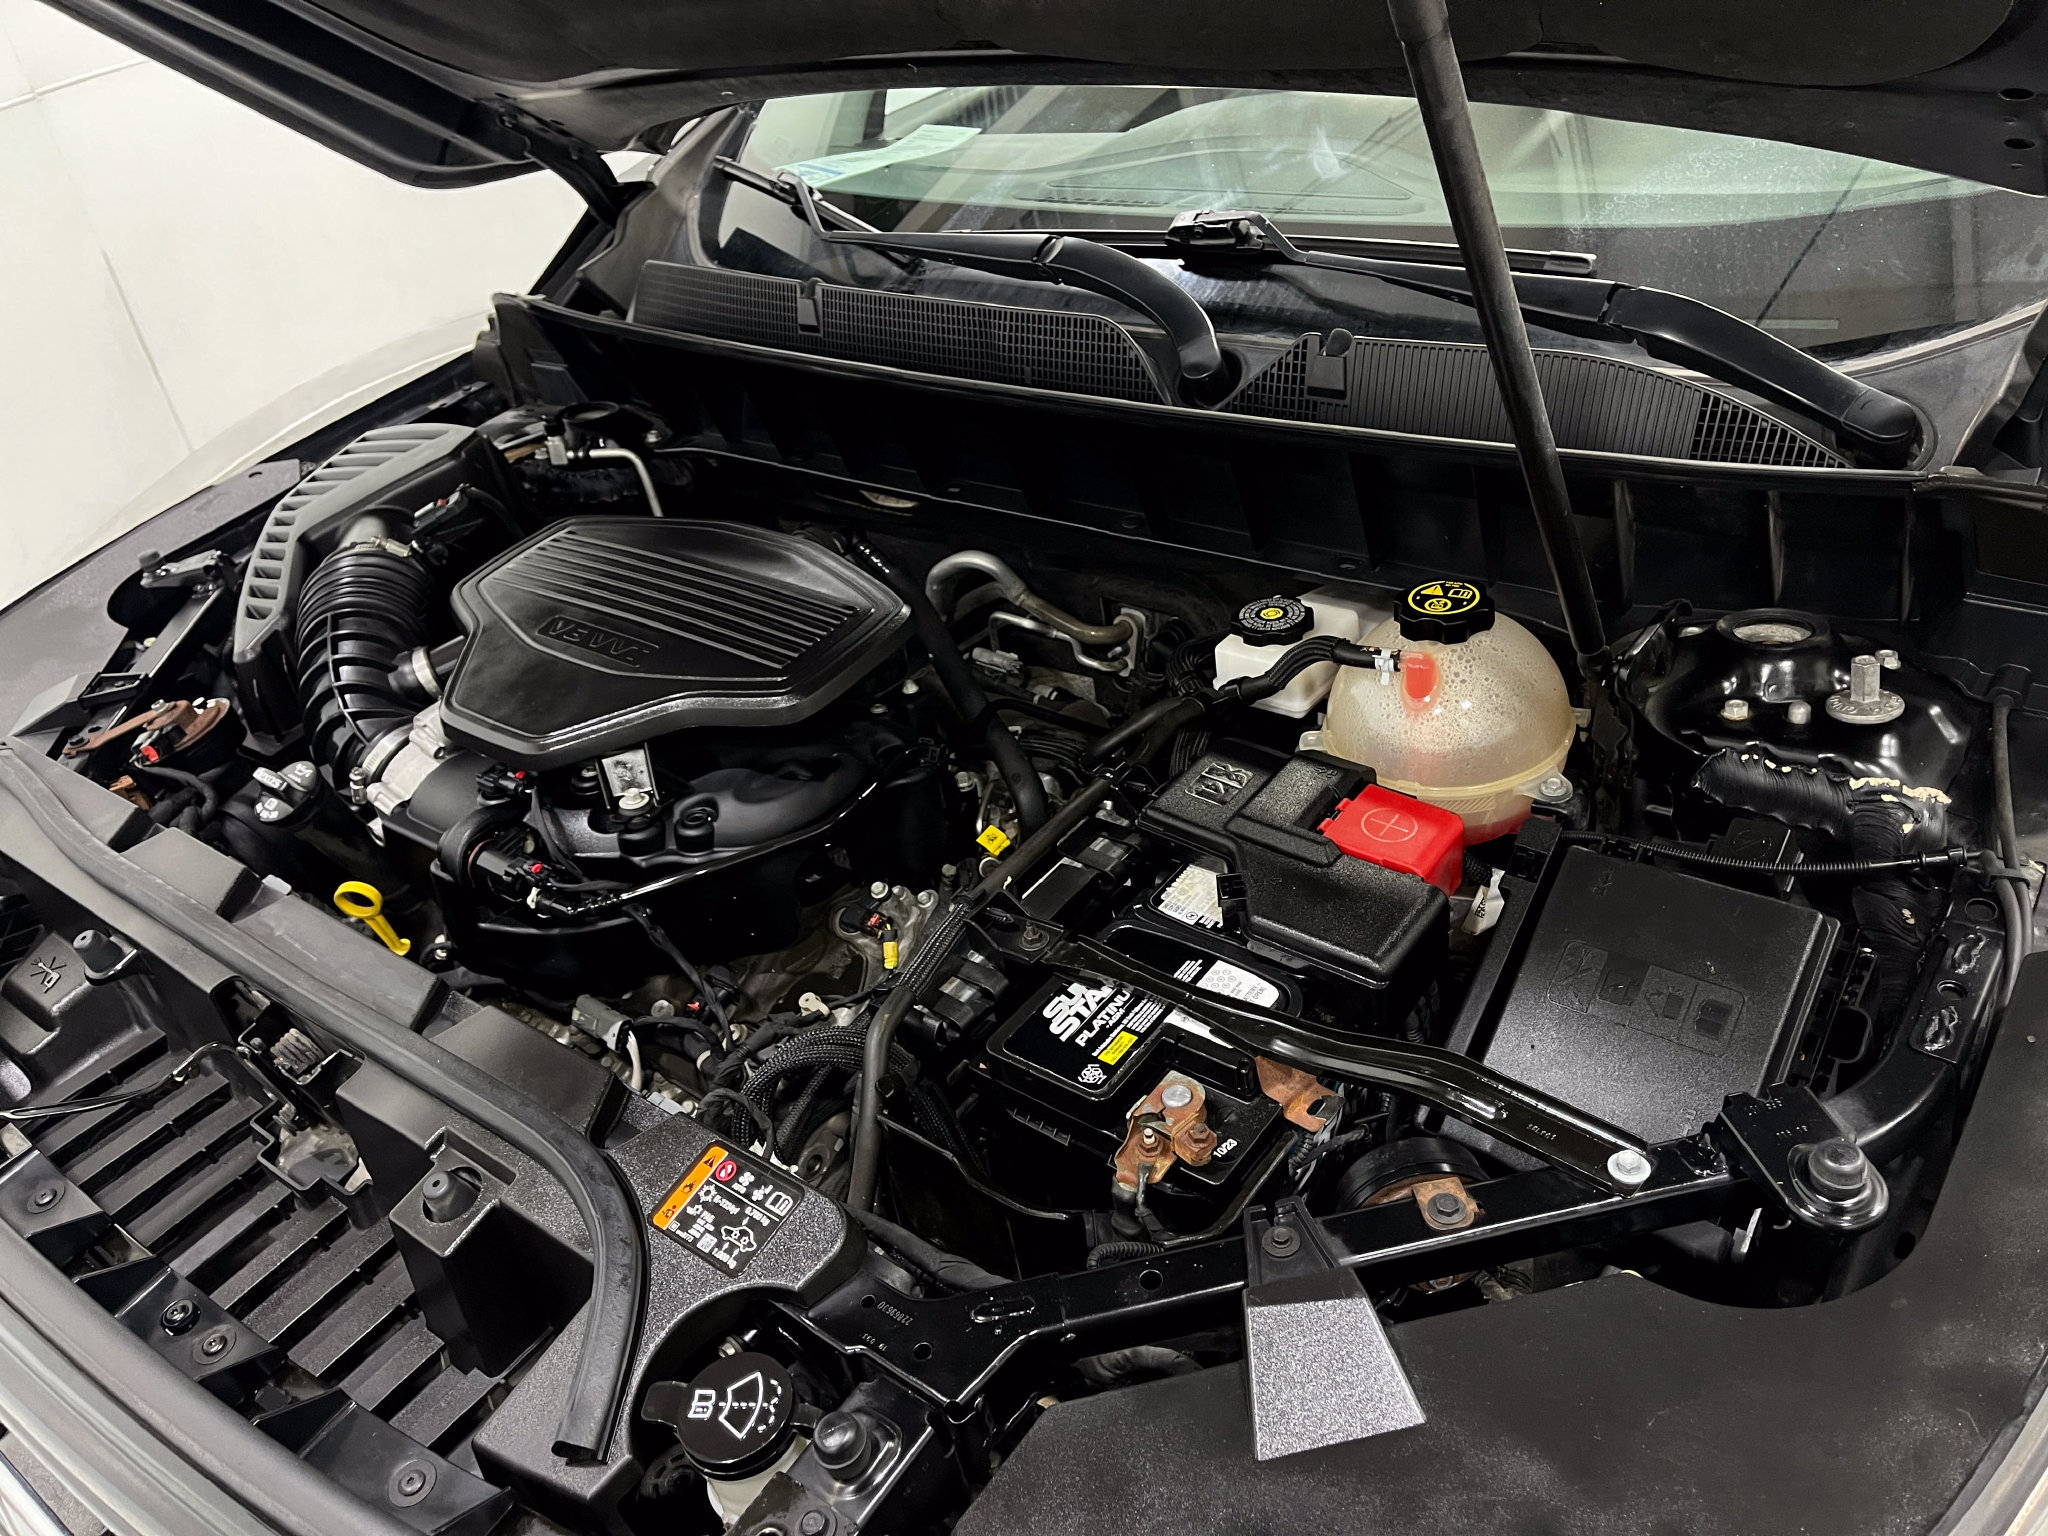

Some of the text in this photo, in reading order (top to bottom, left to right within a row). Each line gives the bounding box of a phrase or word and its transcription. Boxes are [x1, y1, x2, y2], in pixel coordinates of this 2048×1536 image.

[1042, 982, 1089, 1019] SU
[1074, 989, 1131, 1047] PLATINU
[1213, 1138, 1238, 1158] 10/23
